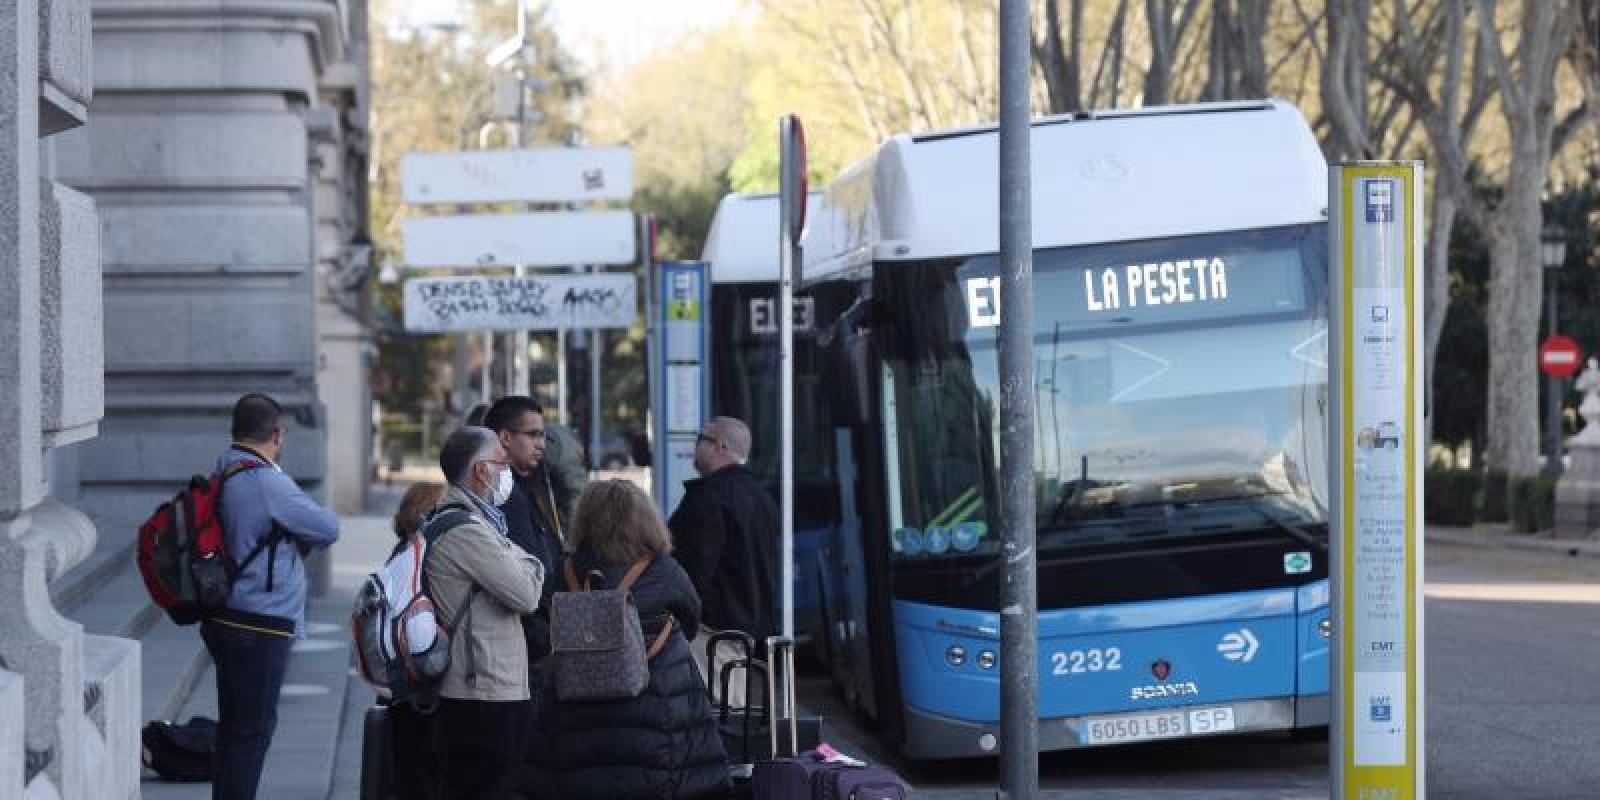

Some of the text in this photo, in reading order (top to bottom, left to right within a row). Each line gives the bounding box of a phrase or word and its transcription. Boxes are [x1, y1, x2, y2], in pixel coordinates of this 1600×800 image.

[1085, 268, 1120, 310] LA
[1127, 257, 1228, 307] PESETA
[1371, 641, 1393, 651] EMT
[1052, 647, 1121, 676] 2232
[1130, 681, 1199, 700] SCANIA
[1090, 719, 1139, 740] 6050
[1194, 709, 1228, 731] SP
